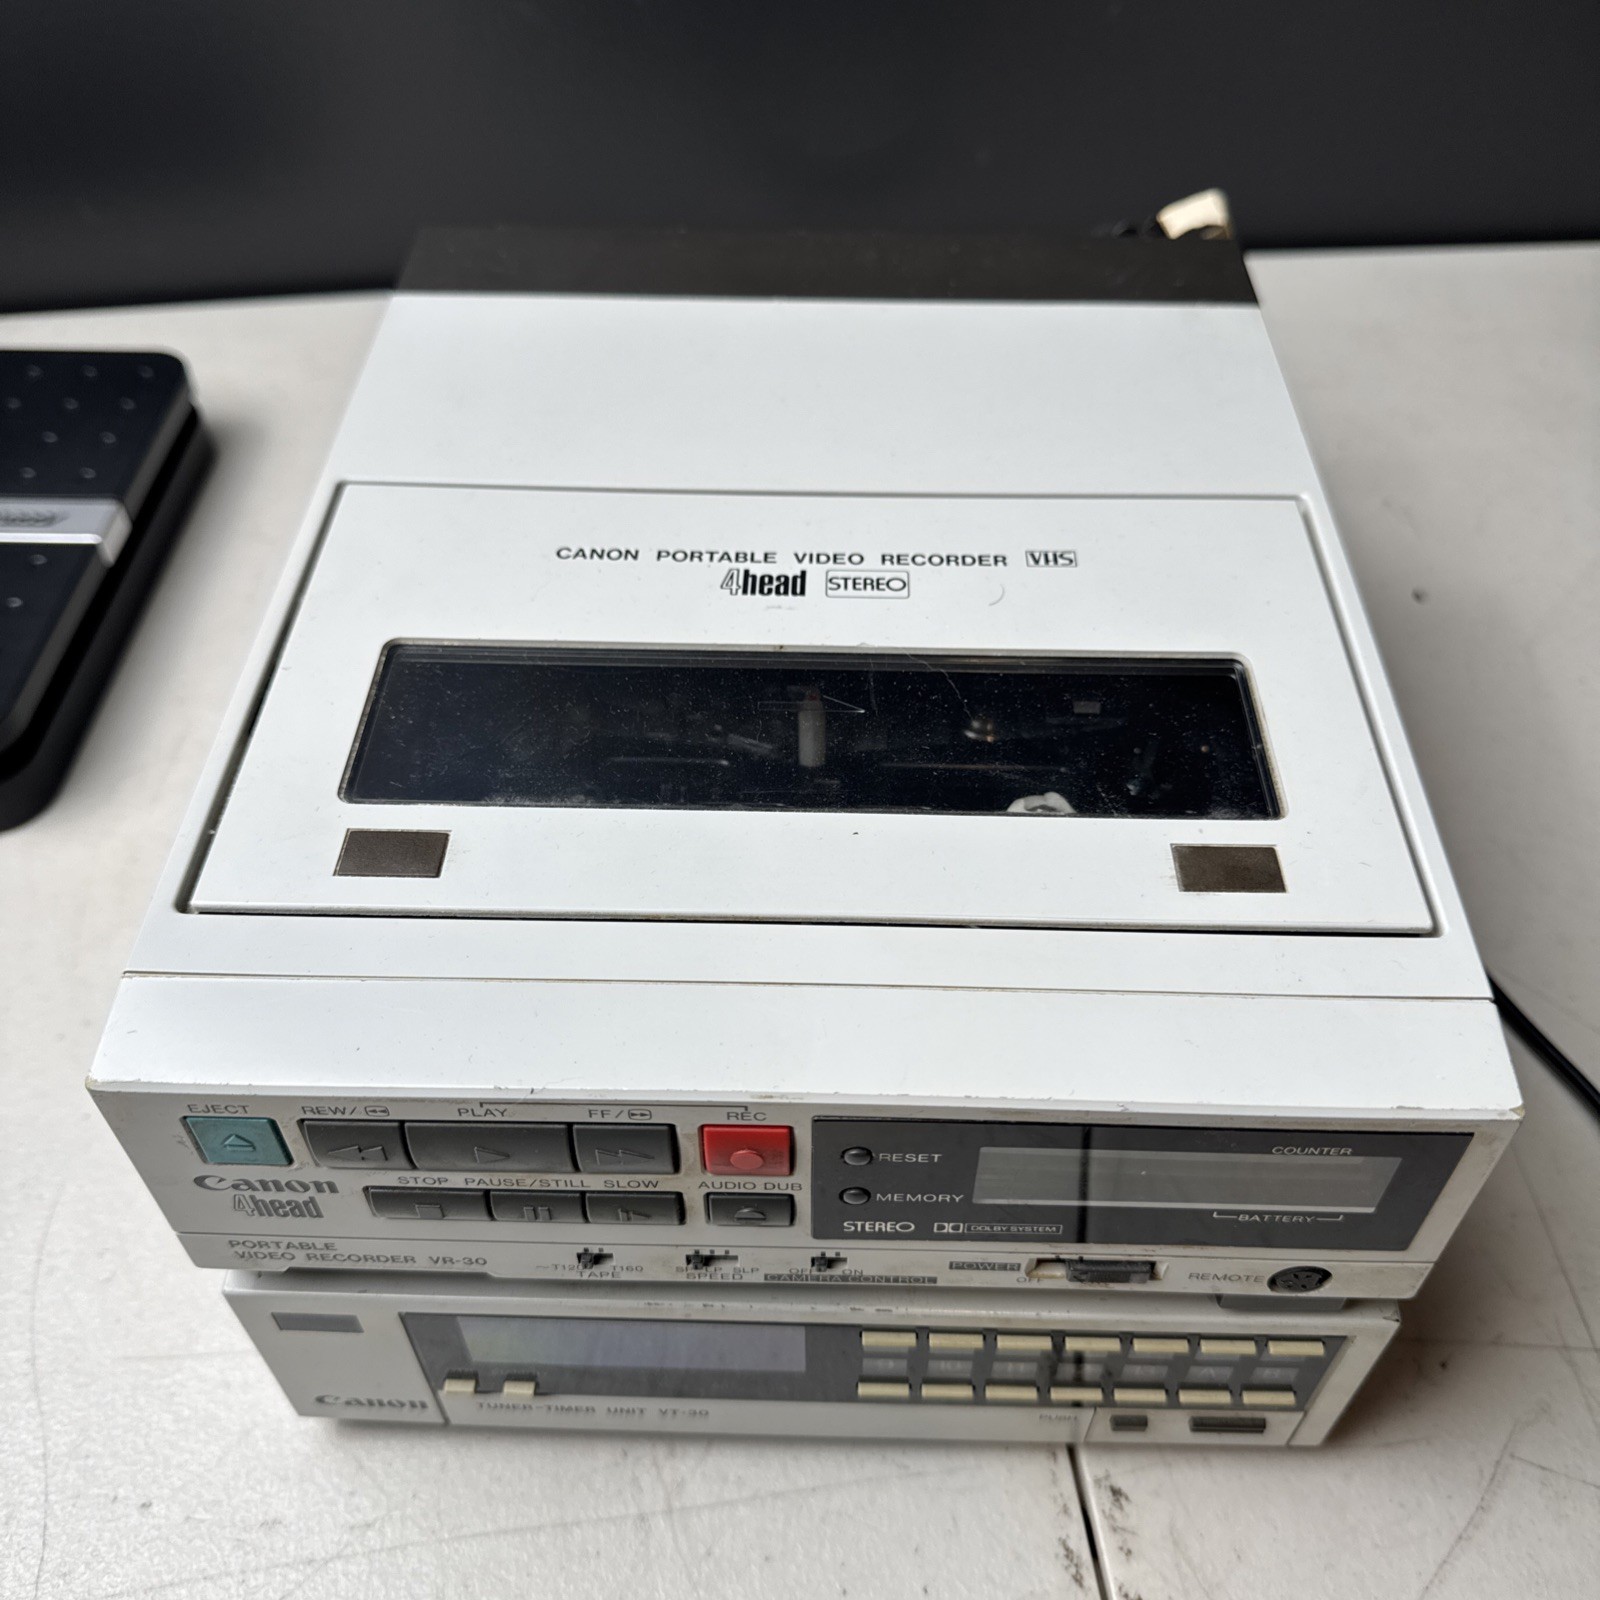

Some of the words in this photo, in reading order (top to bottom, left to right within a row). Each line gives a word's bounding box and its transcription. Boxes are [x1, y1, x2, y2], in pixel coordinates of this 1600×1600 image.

[555, 546, 640, 562] CANON
[655, 549, 777, 565] PORTABLE
[793, 551, 865, 566] VIDEO
[880, 552, 1008, 567] RECORDER
[1028, 552, 1075, 567] VHS
[720, 567, 807, 597] 4head
[827, 575, 908, 592] STEREO
[187, 1103, 249, 1116] EJECT
[457, 1107, 508, 1119] PLAY
[726, 1111, 768, 1122] REC
[1272, 1146, 1353, 1156] COUNTER
[879, 1152, 943, 1163] RESET
[193, 1174, 340, 1195] Canon
[397, 1175, 449, 1187] STOP
[464, 1176, 591, 1189] PAUSE/STILL
[604, 1178, 660, 1190] SLOW
[698, 1180, 761, 1191] AUDIO
[763, 1181, 803, 1192] DUB
[876, 1192, 965, 1203] MEMORY
[233, 1193, 325, 1219] 4head
[1238, 1213, 1316, 1223] BATTERY
[843, 1221, 916, 1233] STEREO
[970, 1225, 1007, 1233] DOLBY
[228, 1239, 338, 1251] PORTABLE
[234, 1250, 297, 1261] VIDEO
[306, 1253, 417, 1265] RECORDER
[428, 1256, 488, 1267] VR-30
[611, 1265, 644, 1273] T160
[842, 1268, 864, 1276] ON
[951, 1261, 1021, 1272] POWER
[576, 1271, 622, 1279] TAPE
[685, 1272, 744, 1281] SPEED
[766, 1274, 843, 1282] CAMERA
[848, 1275, 936, 1284] CONTROL
[1188, 1271, 1266, 1283] REMOTE
[314, 1394, 429, 1409] Canon
[606, 1406, 647, 1416] UNIT
